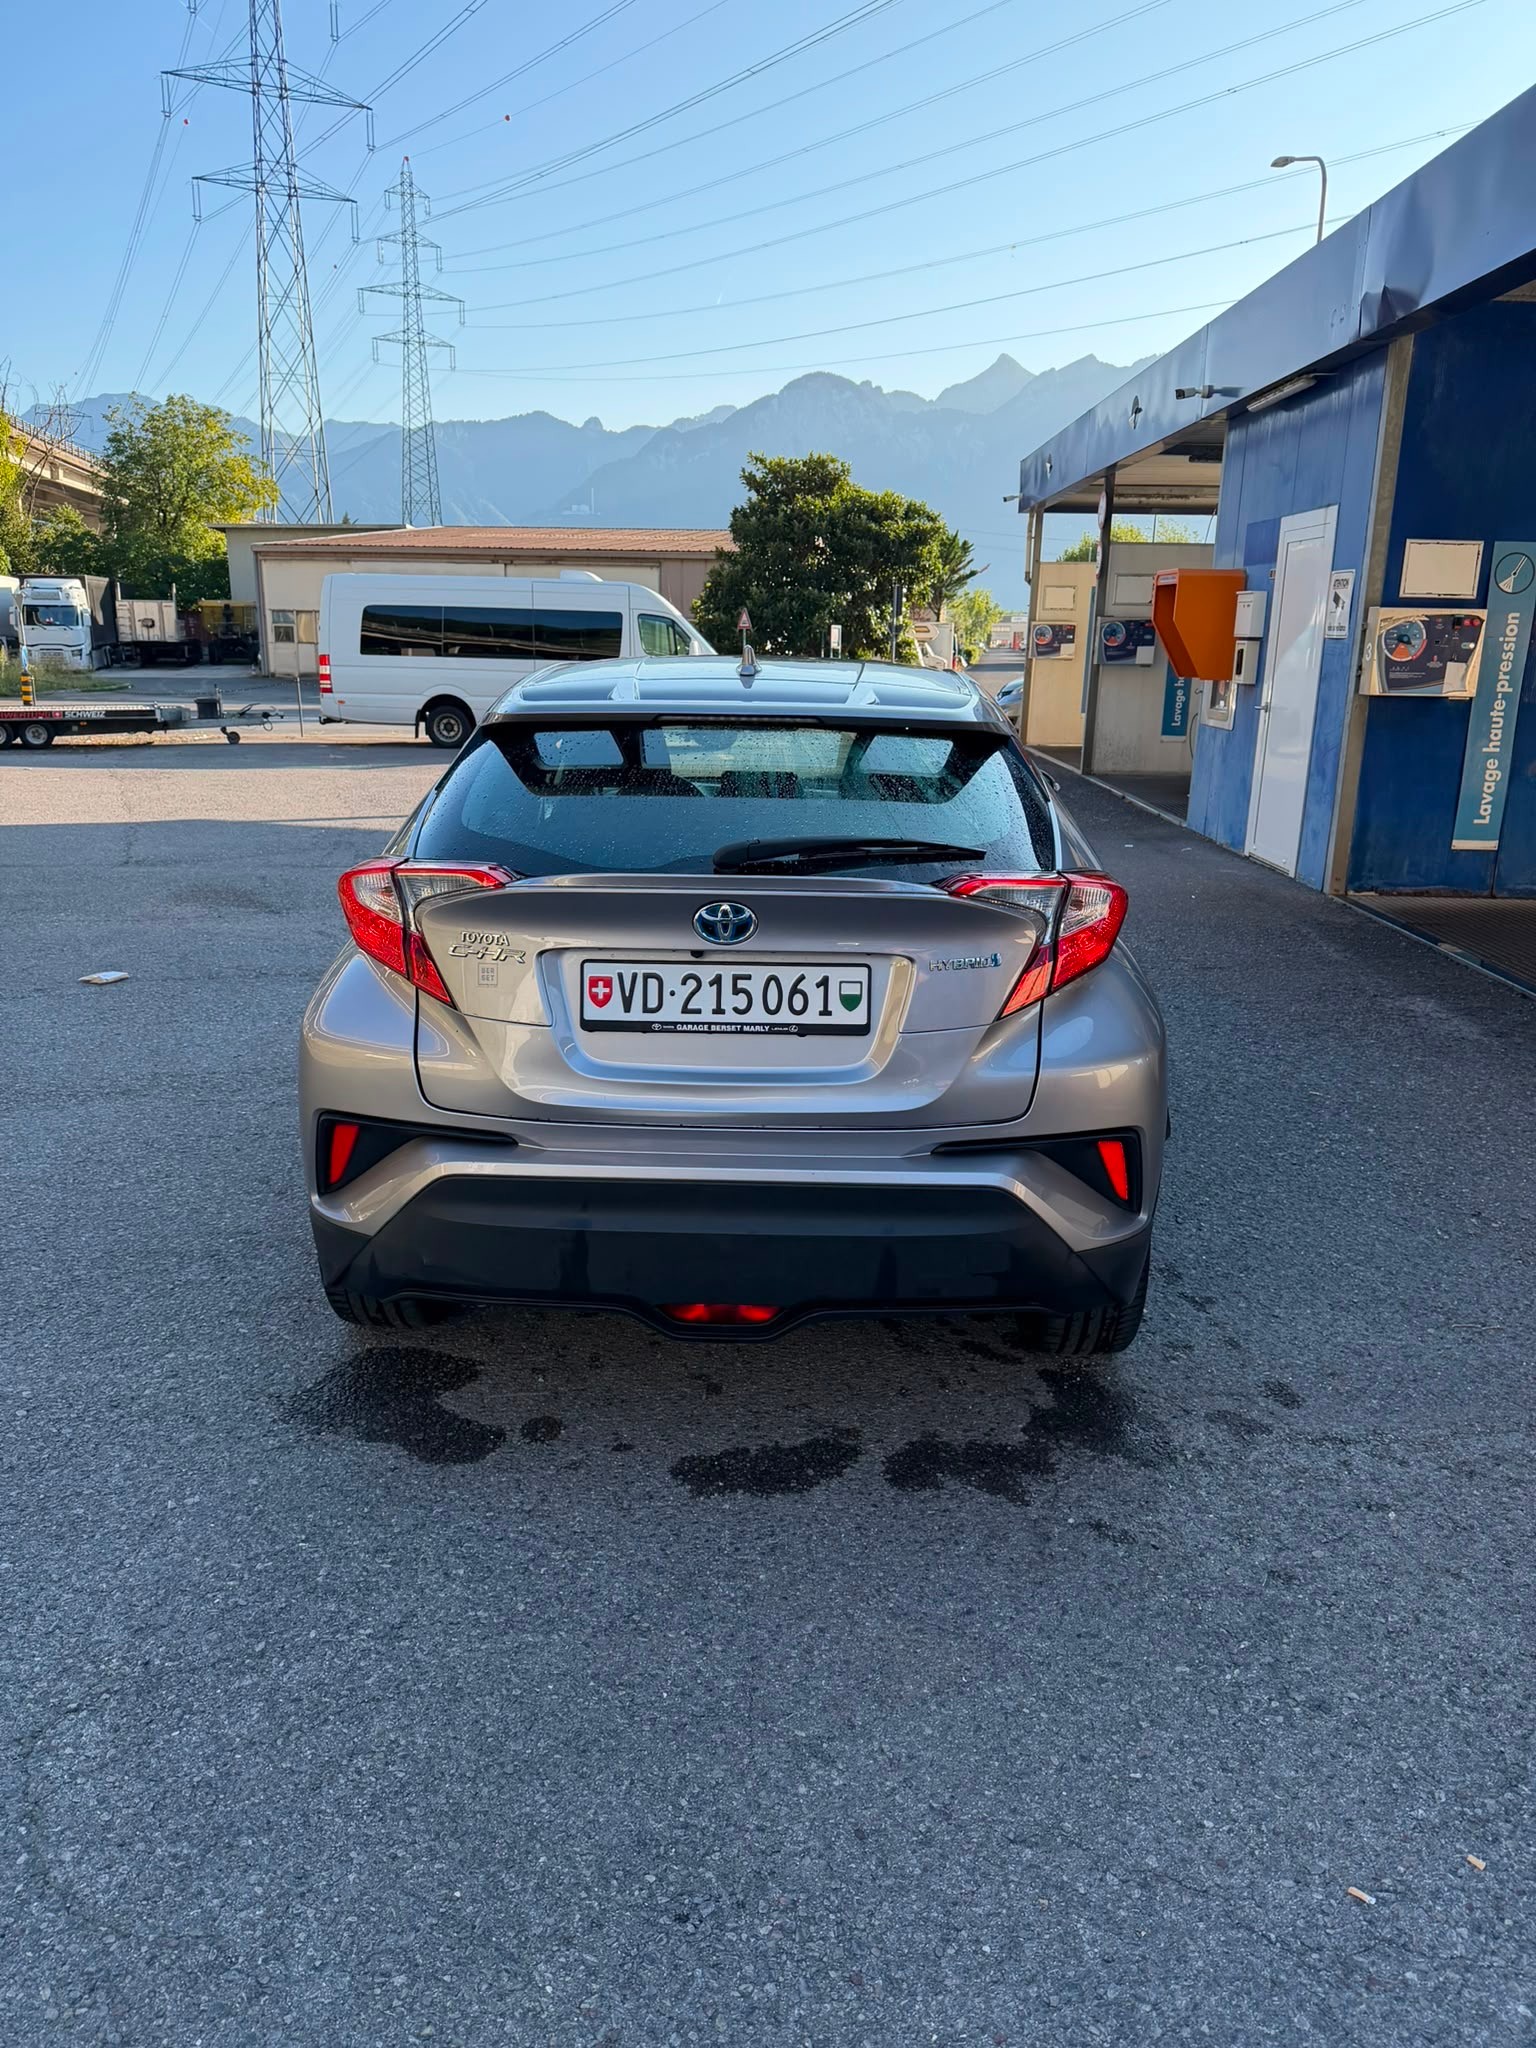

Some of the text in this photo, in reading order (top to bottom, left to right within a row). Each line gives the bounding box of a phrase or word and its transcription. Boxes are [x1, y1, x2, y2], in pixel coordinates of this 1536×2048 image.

[1171, 689, 1186, 727] Lavage
[1473, 612, 1521, 824] Lavage haute-pression
[461, 931, 510, 946] TOYOTA
[448, 944, 526, 964] C-HR
[929, 957, 991, 971] HYBRID
